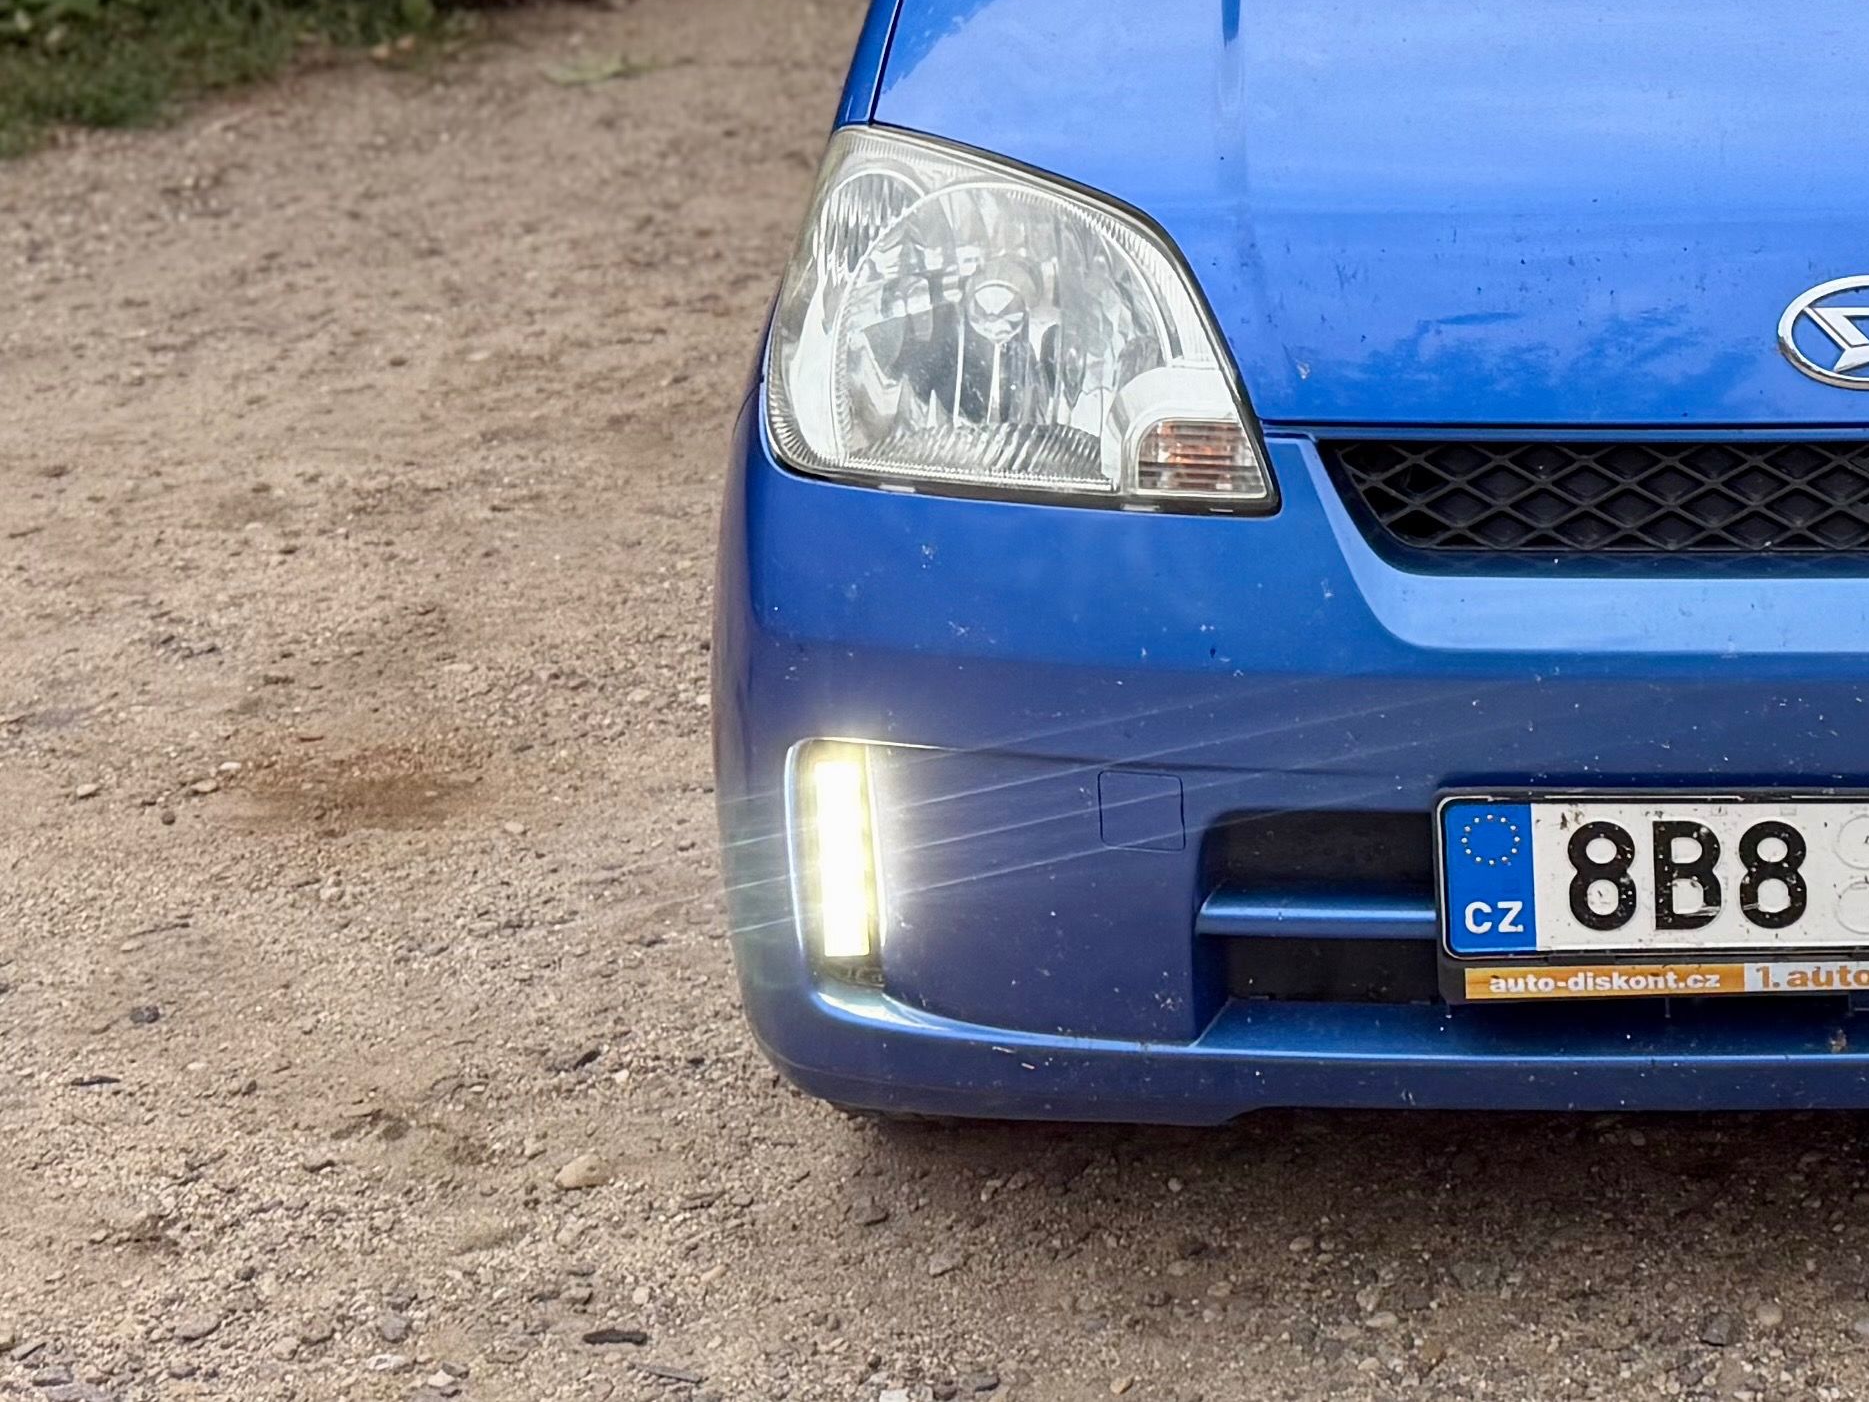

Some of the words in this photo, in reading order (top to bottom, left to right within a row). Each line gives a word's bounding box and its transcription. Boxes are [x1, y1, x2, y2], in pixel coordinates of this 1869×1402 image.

[1565, 819, 1809, 931] 8B8
[1464, 901, 1524, 935] CZ
[1489, 970, 1721, 994] auto-diskont.cz
